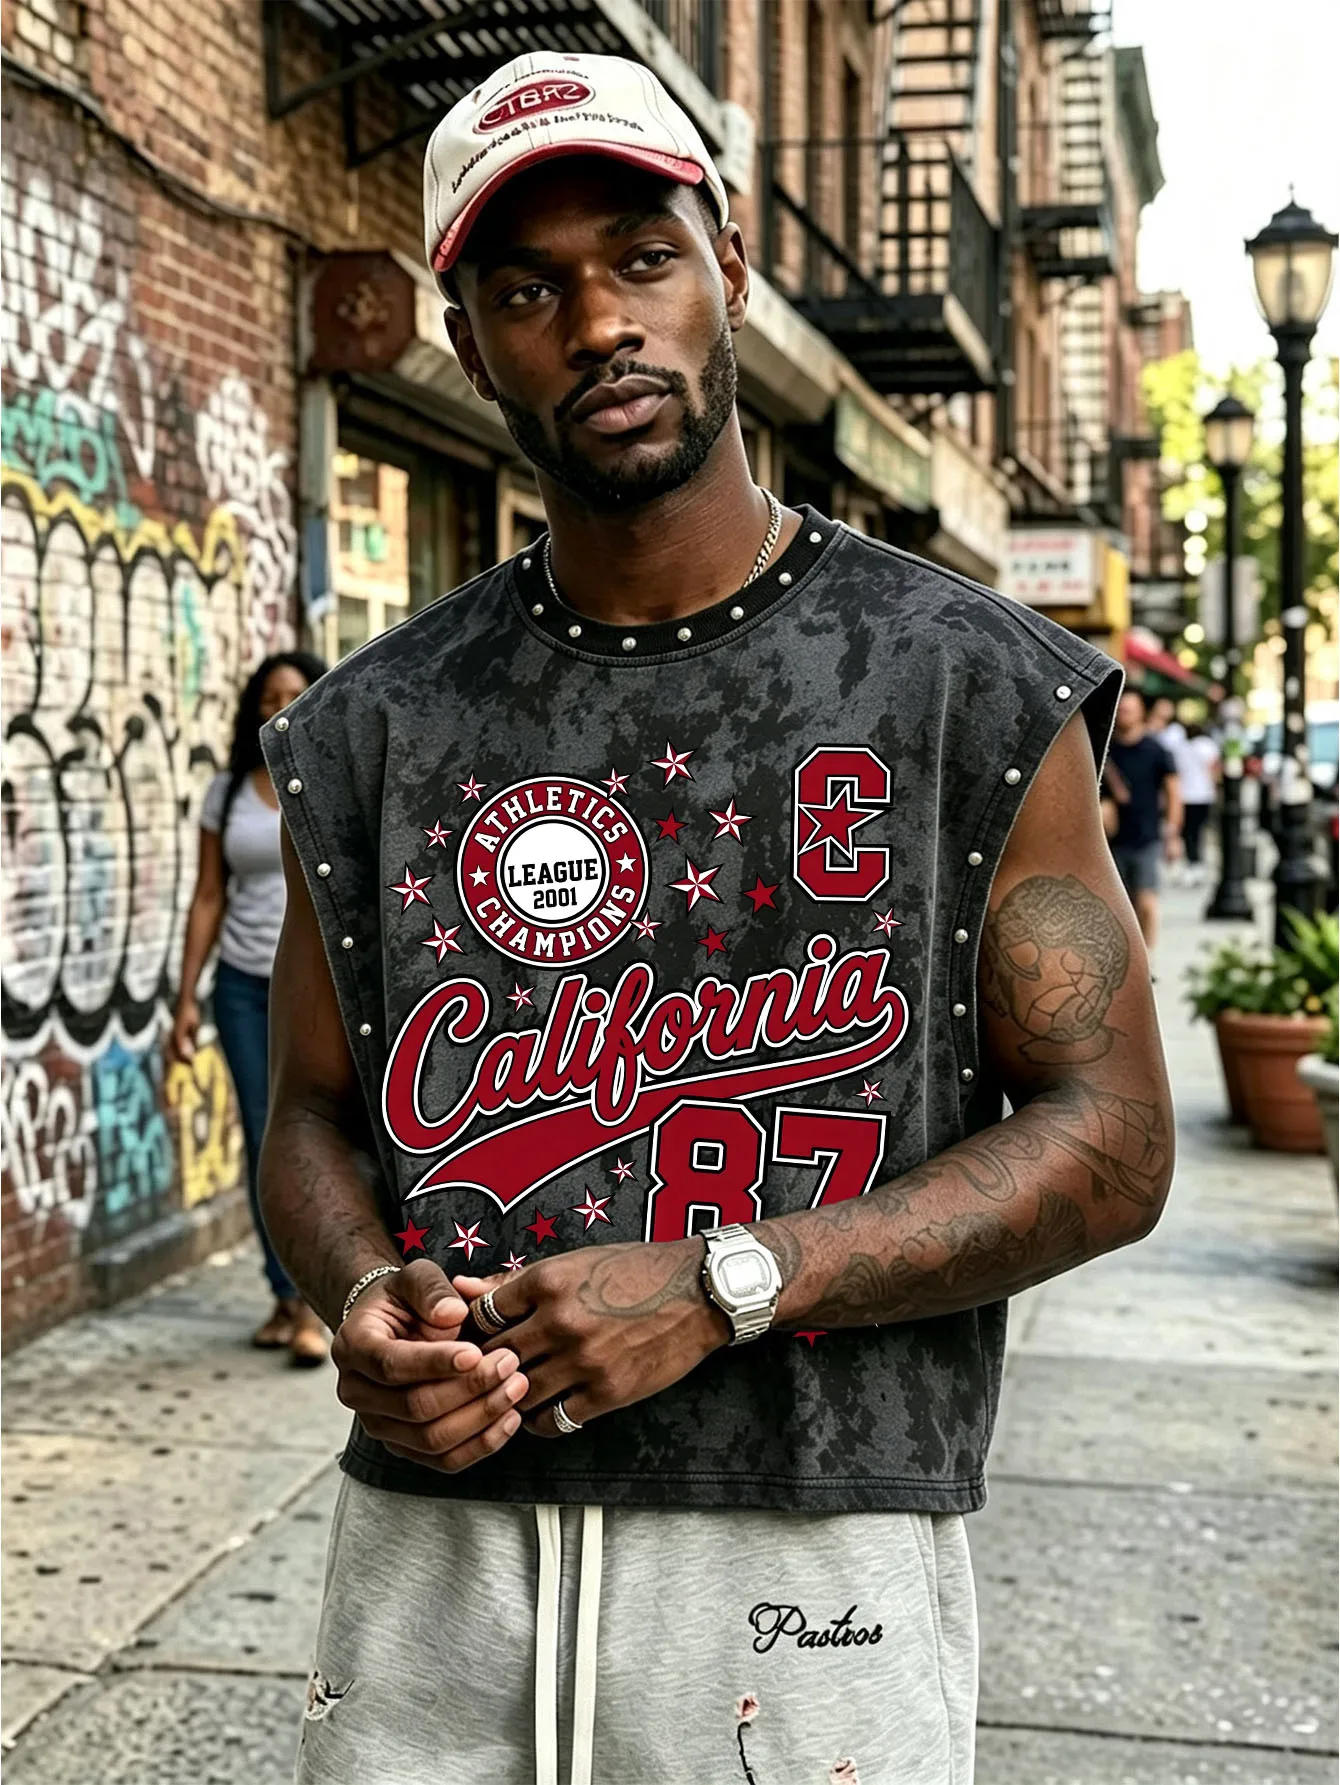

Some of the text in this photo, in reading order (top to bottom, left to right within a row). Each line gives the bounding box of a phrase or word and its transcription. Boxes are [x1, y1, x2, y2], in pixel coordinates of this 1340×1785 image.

[474, 786, 629, 854] ATHLETICS
[508, 858, 599, 887] LEAGUE
[533, 886, 578, 909] 2001
[476, 884, 636, 958] CHAMPIONS
[382, 933, 904, 1155] California
[645, 1099, 887, 1243] 87
[748, 1602, 883, 1654] Pastros
